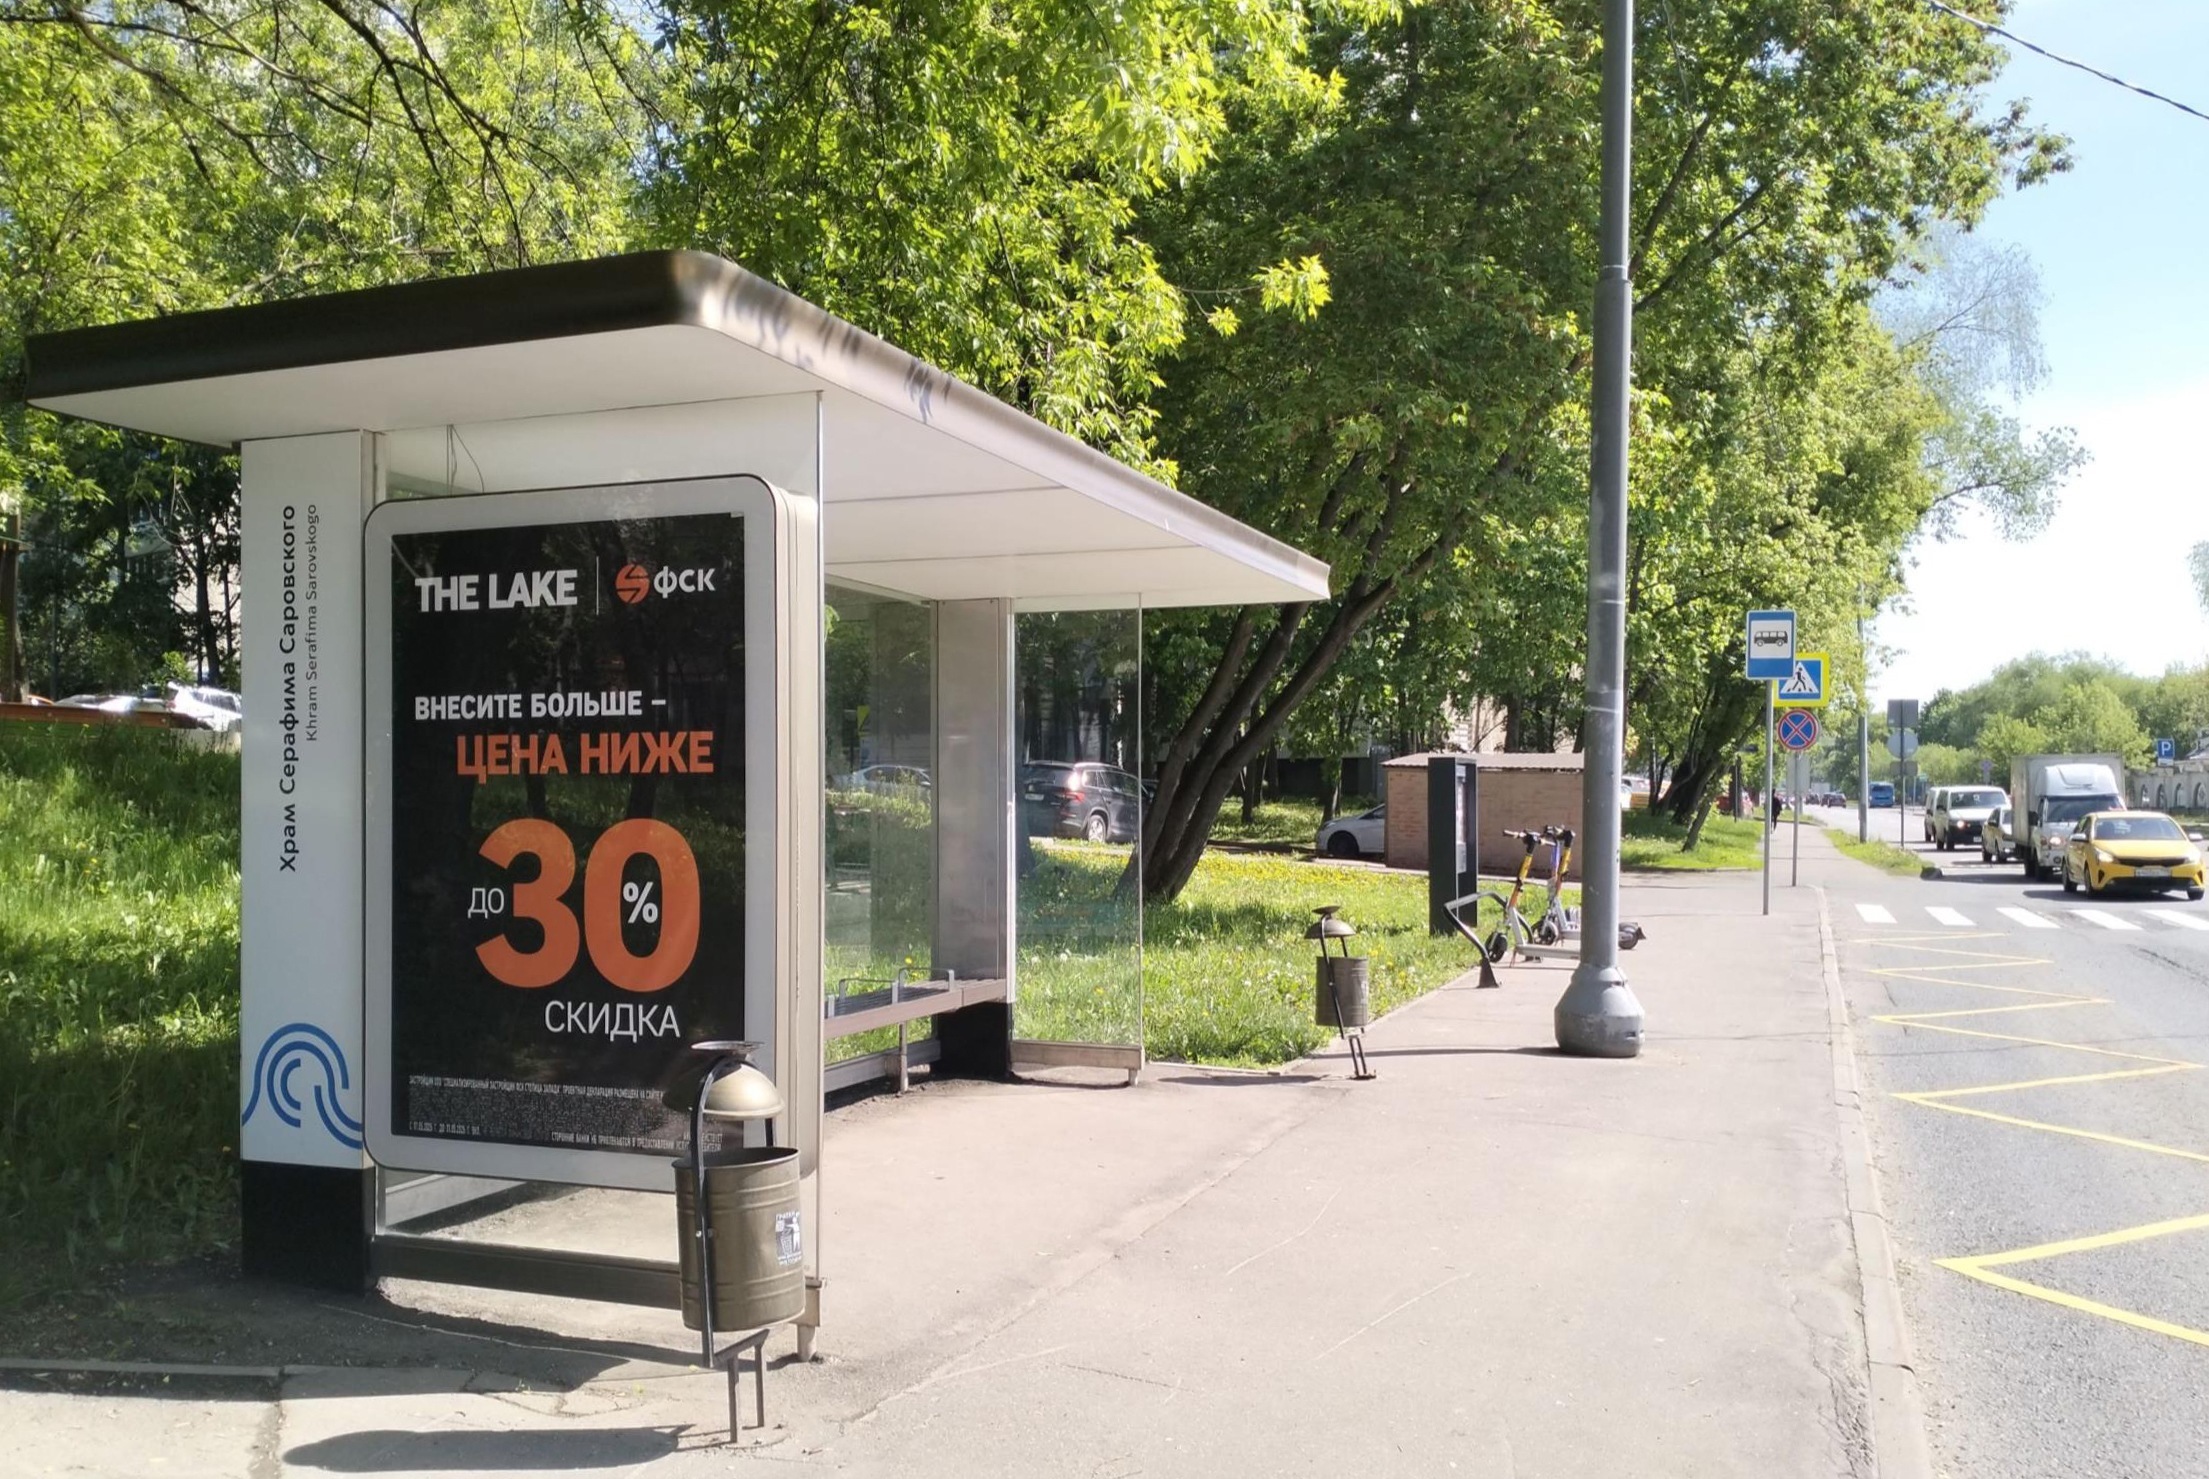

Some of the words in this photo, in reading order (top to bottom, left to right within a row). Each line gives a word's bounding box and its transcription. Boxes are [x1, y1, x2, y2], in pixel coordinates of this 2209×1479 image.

[306, 503, 319, 600] Sarovskogo
[279, 505, 299, 654] Саровского
[415, 574, 479, 613] THE
[488, 569, 578, 609] LAKE
[653, 566, 716, 599] ФСК
[306, 605, 318, 681] Serafima
[279, 662, 299, 794] Серафима
[306, 685, 318, 742] Khram
[415, 693, 522, 721] ВНЕСИТЕ
[531, 690, 643, 718] БОЛЬШЕ
[456, 734, 568, 784] ЦЕНА
[580, 731, 714, 775] НИЖЕ
[279, 803, 299, 872] Храм
[467, 887, 505, 919] ДО
[544, 1000, 681, 1043] СКИДКА
